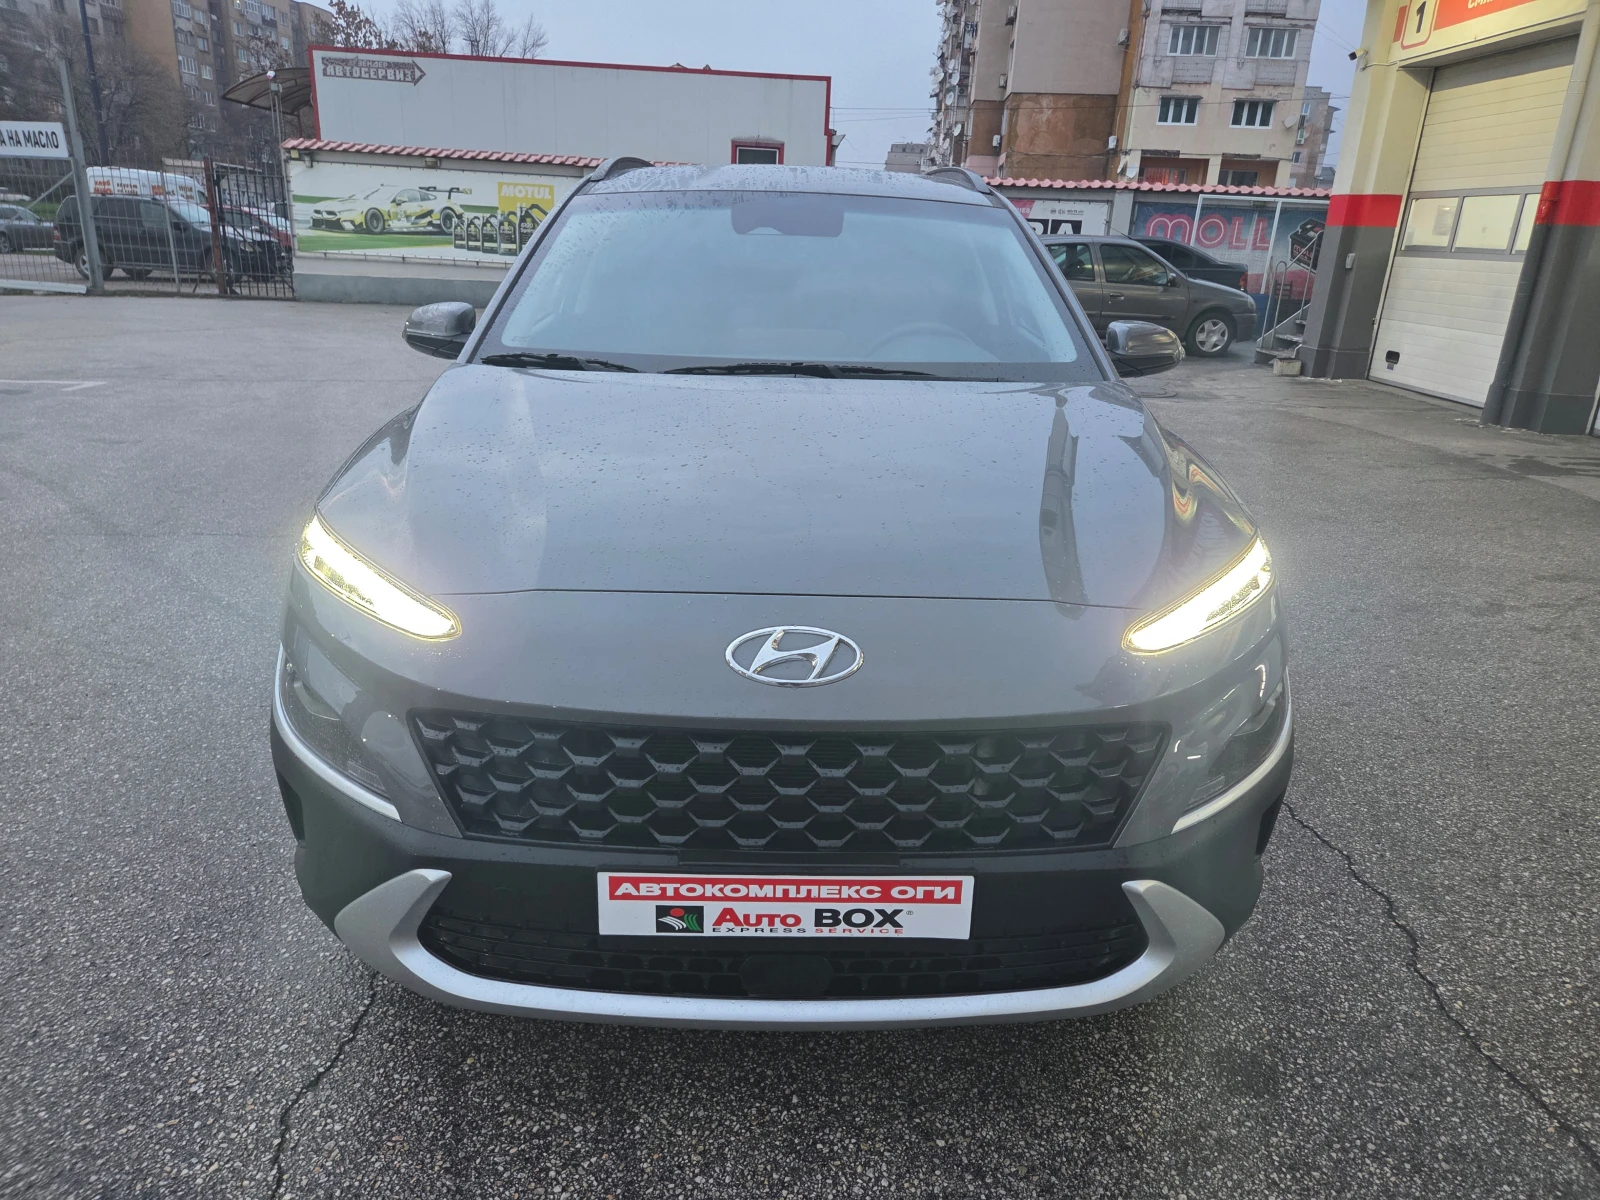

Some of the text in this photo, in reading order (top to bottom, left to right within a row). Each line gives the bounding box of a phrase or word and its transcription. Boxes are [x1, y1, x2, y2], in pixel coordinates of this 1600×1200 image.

[1416, 1, 1426, 34] 1
[326, 65, 412, 81] АВТОСЕРВИЗ
[6, 129, 22, 147] НА
[22, 130, 59, 149] МАСЛО
[501, 184, 552, 200] MOTUL
[1146, 213, 1271, 250] MOLL
[614, 882, 957, 900] АВТОКОМПЛЕКС ОГИ
[814, 908, 904, 928] BOX
[815, 927, 904, 935] SERVICE
